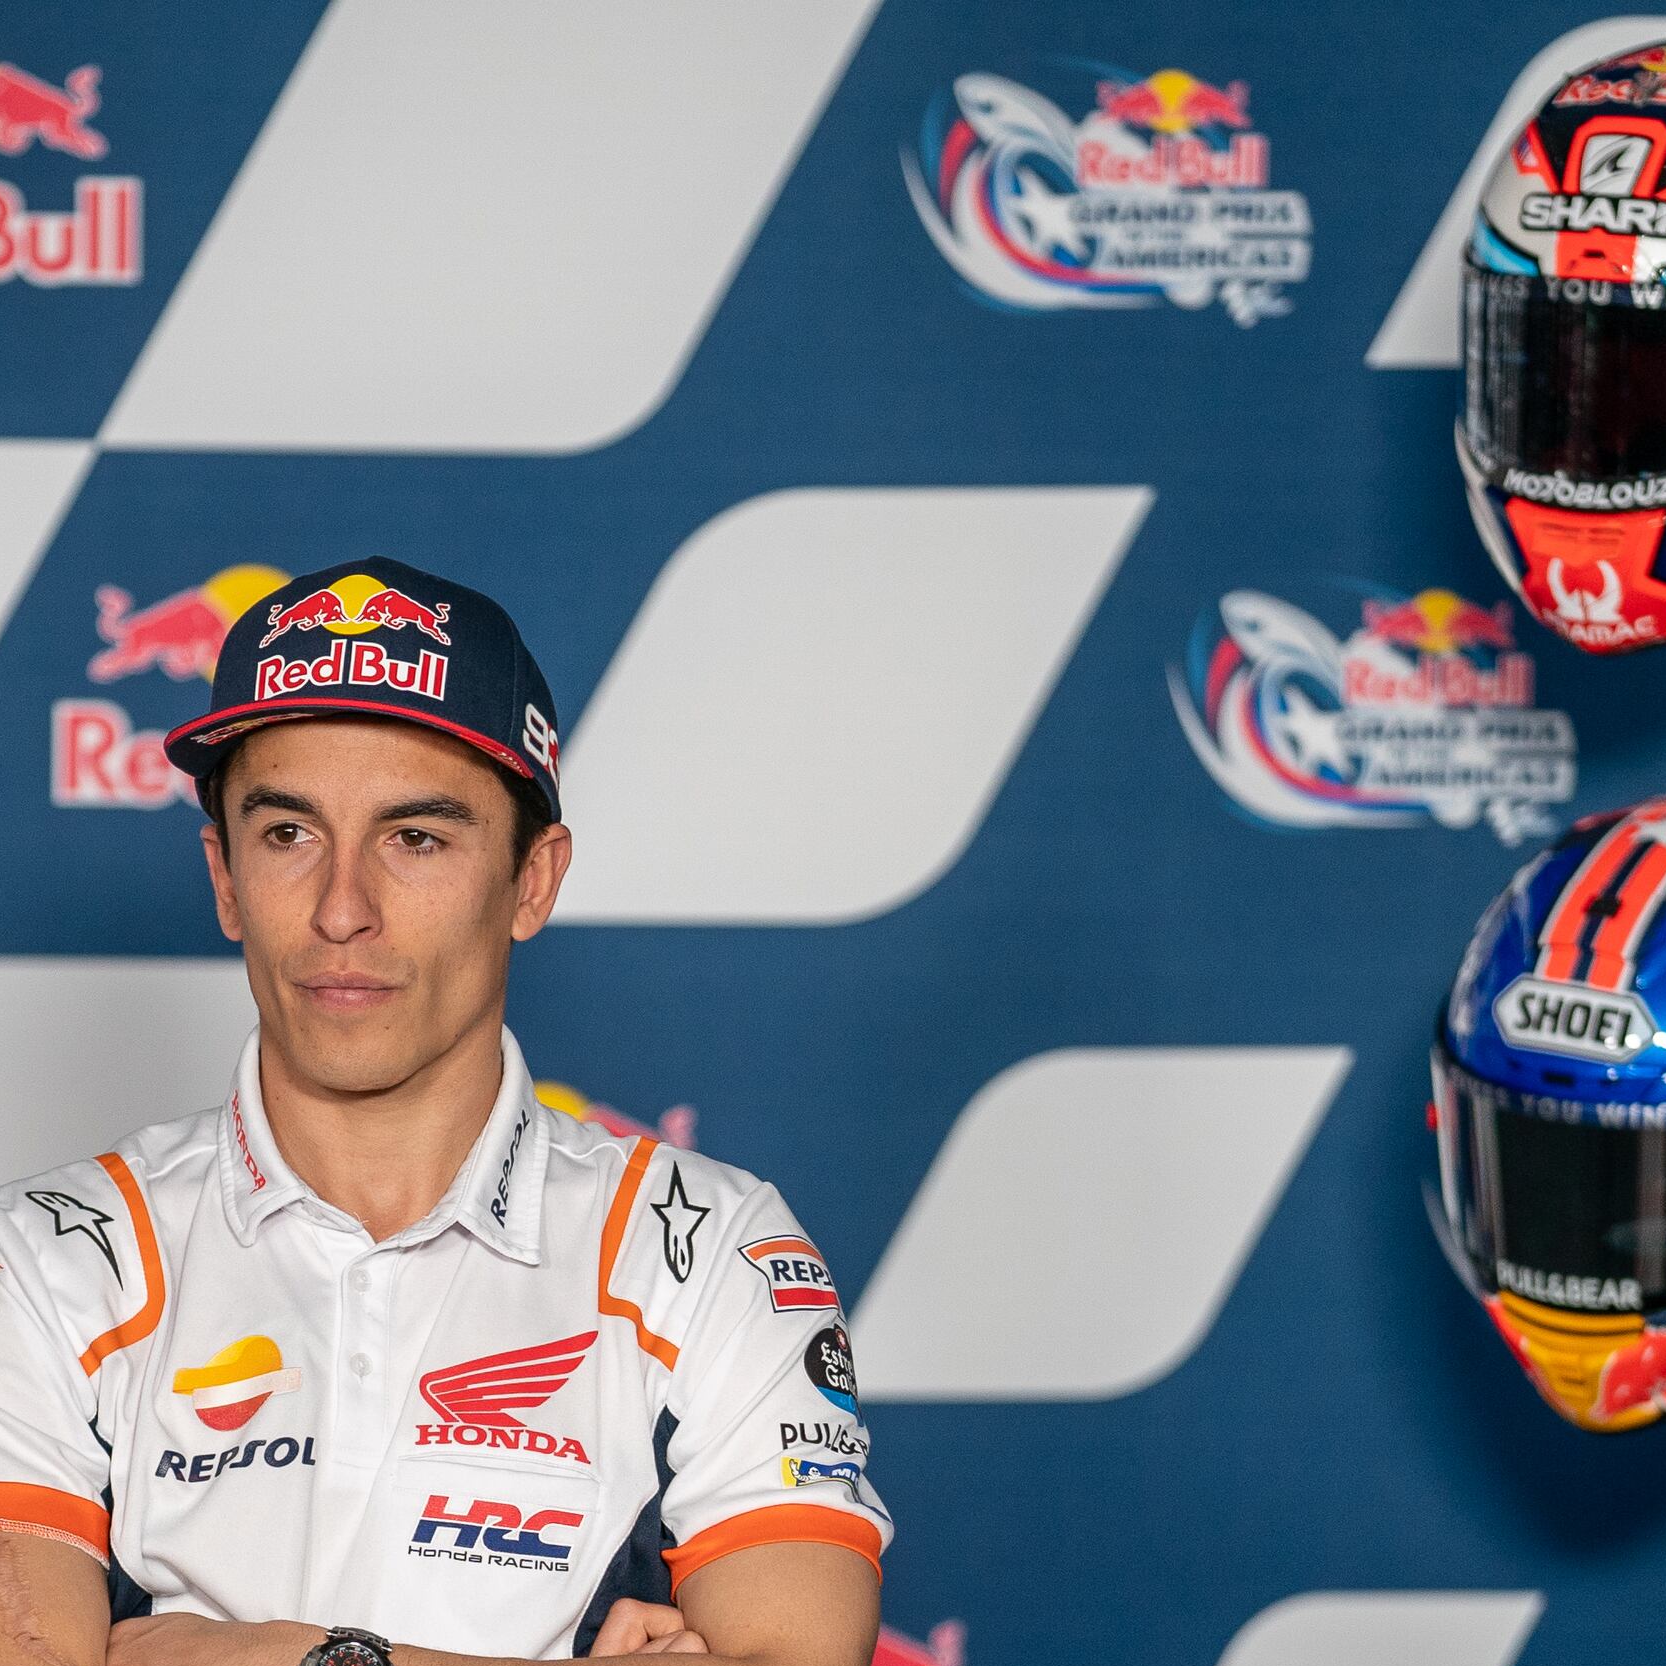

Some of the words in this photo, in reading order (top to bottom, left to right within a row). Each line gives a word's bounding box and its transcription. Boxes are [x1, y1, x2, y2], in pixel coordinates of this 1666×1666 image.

[1077, 134, 1168, 186] Red
[1174, 133, 1269, 187] Bull
[1545, 276, 1613, 306] YOU
[255, 639, 347, 701] Red
[348, 641, 449, 701] Bull
[1344, 652, 1434, 706] Red
[1439, 652, 1535, 707] Bull
[55, 704, 201, 803] Re
[1513, 989, 1633, 1049] SHOEI
[490, 1108, 531, 1229] REPSOL
[155, 1436, 316, 1483] REPSOL
[415, 1424, 591, 1465] HONDA
[411, 1494, 584, 1560] HRC
[408, 1545, 483, 1563] Honda
[487, 1555, 570, 1572] RACING
